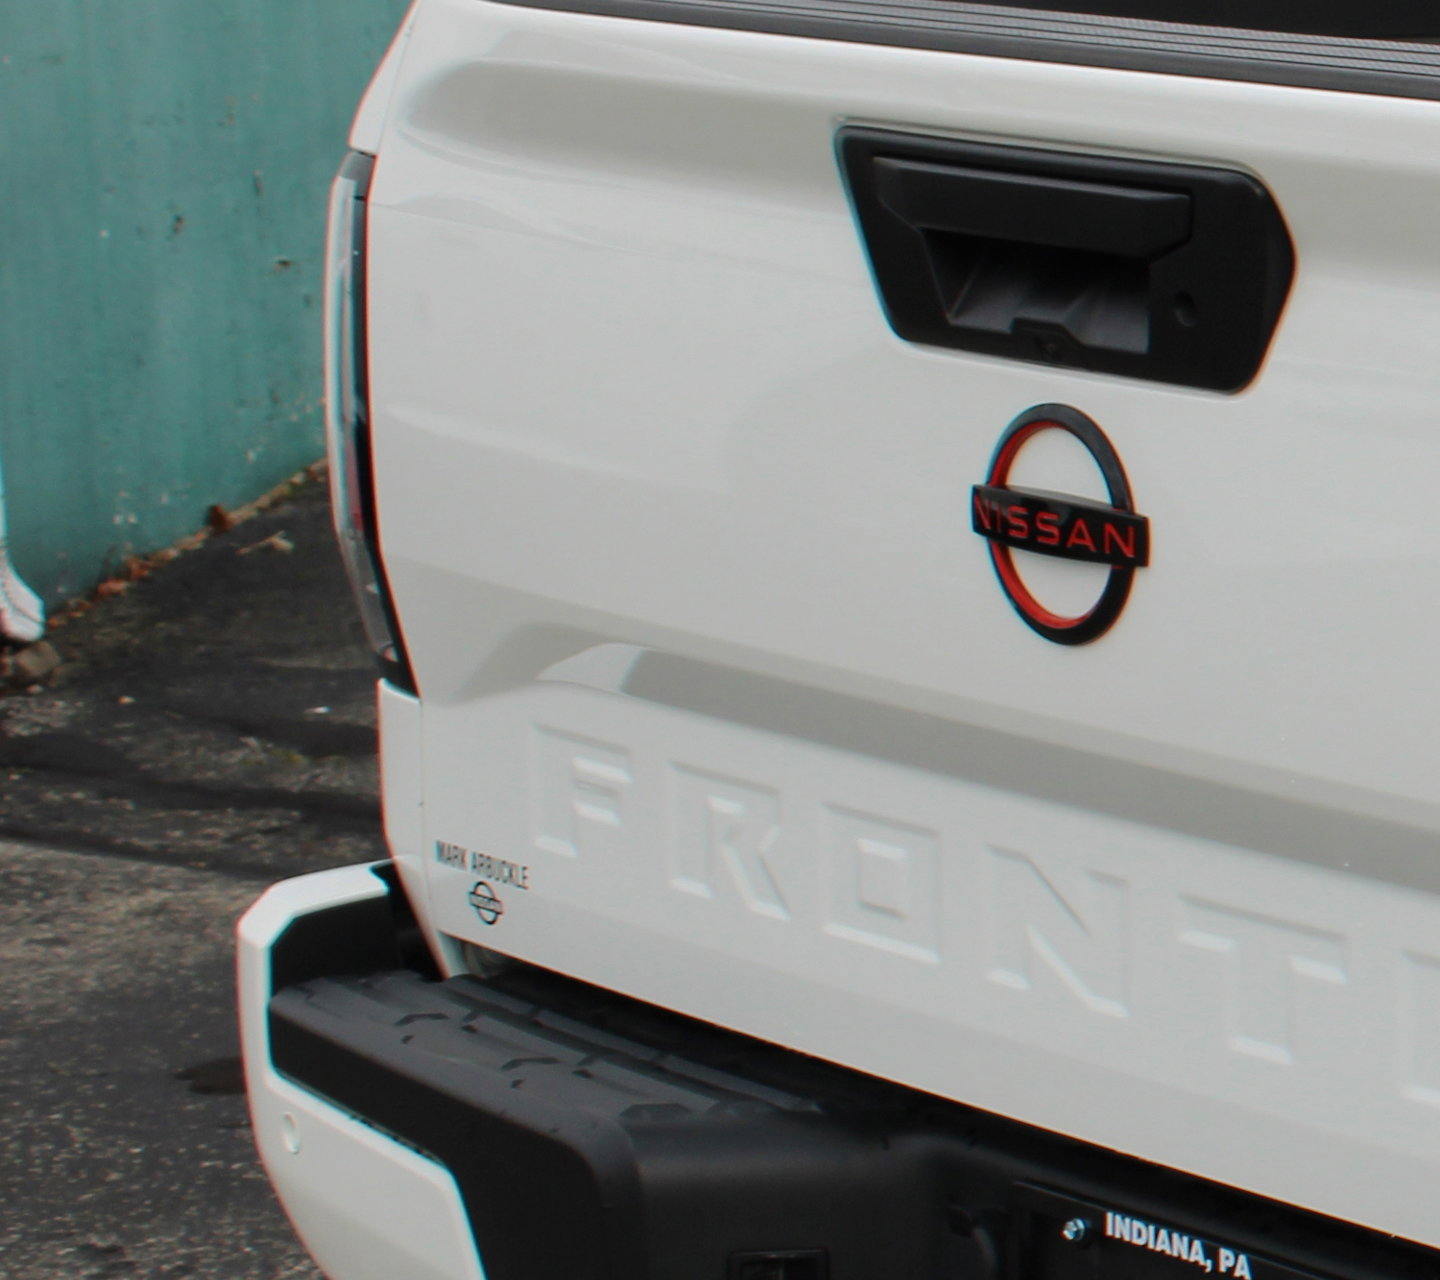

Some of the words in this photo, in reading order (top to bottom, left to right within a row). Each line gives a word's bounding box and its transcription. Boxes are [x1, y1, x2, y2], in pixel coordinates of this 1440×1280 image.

[974, 493, 1136, 558] NISSAN
[436, 840, 467, 871] MARK
[471, 851, 529, 890] ARBUCKLE
[1105, 1212, 1213, 1274] INDIANA,
[1218, 1246, 1252, 1280] PA
